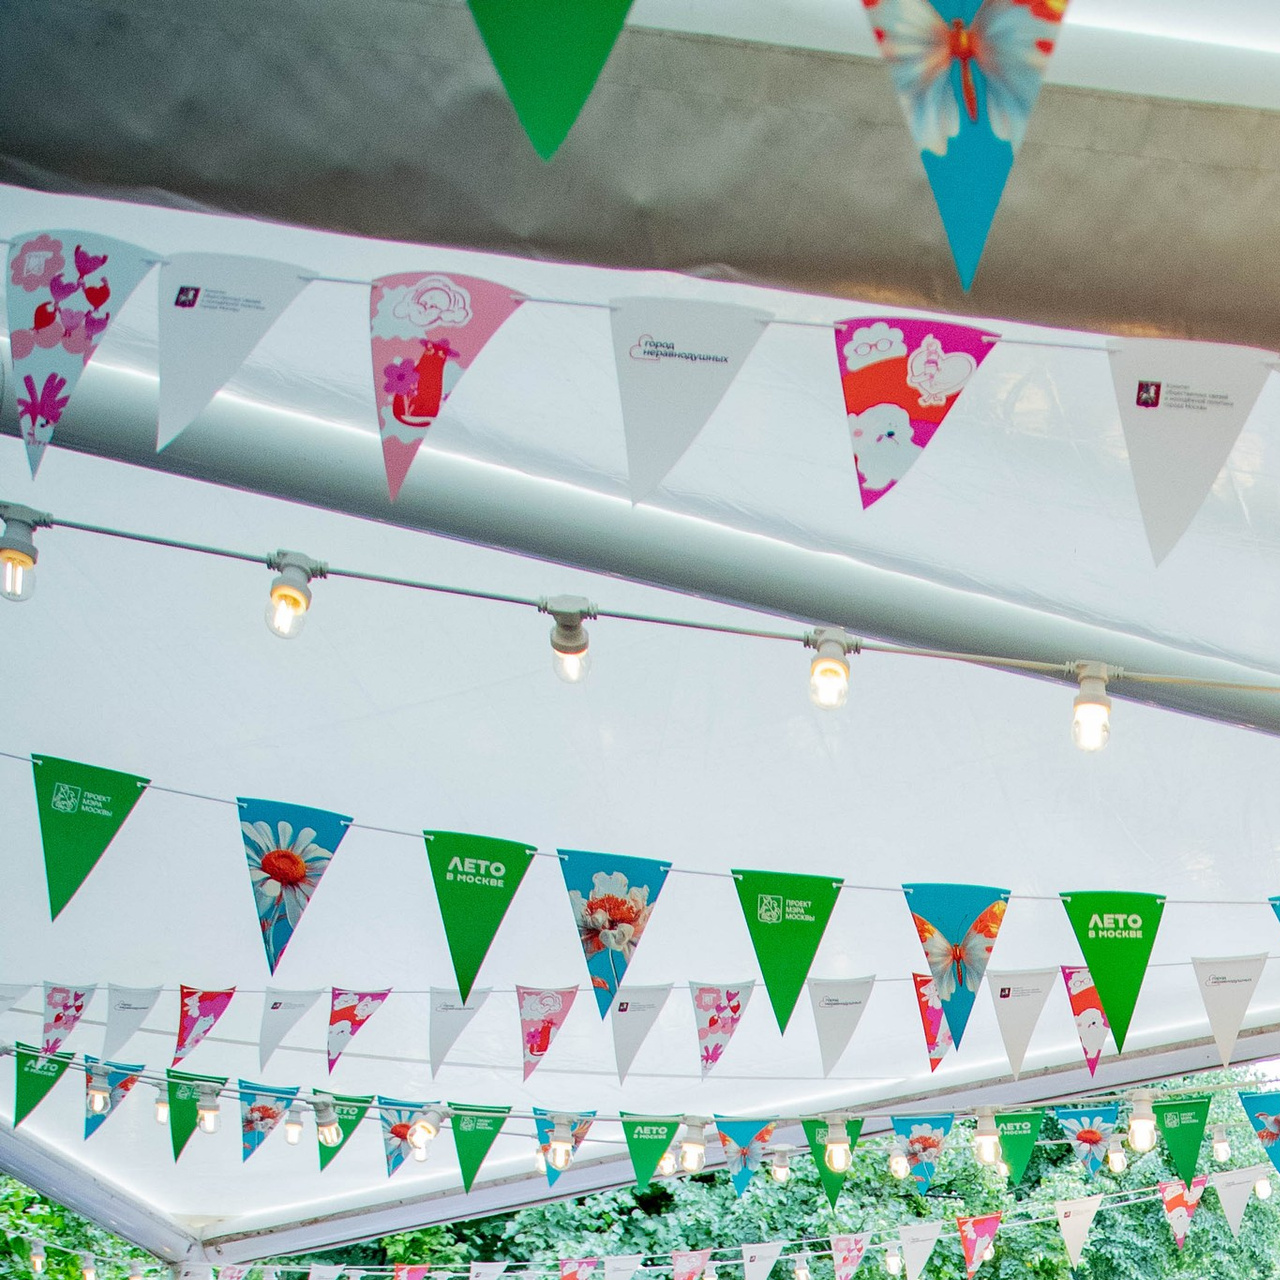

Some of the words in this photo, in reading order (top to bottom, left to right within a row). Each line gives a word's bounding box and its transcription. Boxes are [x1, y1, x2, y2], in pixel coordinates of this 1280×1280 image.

[644, 340, 675, 350] город
[643, 349, 729, 363] неравнодушных
[85, 792, 112, 803] ПРОЕКТ
[82, 806, 113, 817] МОСКВЫ
[449, 857, 506, 877] ЛЕТО
[447, 873, 454, 881] В
[458, 875, 505, 888] МОСКВЕ
[786, 900, 812, 908] ПРОЕКТ
[786, 914, 816, 922] МОСКВЫ
[1089, 914, 1143, 929] ЛЕТО
[1089, 931, 1096, 939] В
[1099, 931, 1143, 939] МОСКВЕ
[635, 1126, 668, 1135] ЛЕТО
